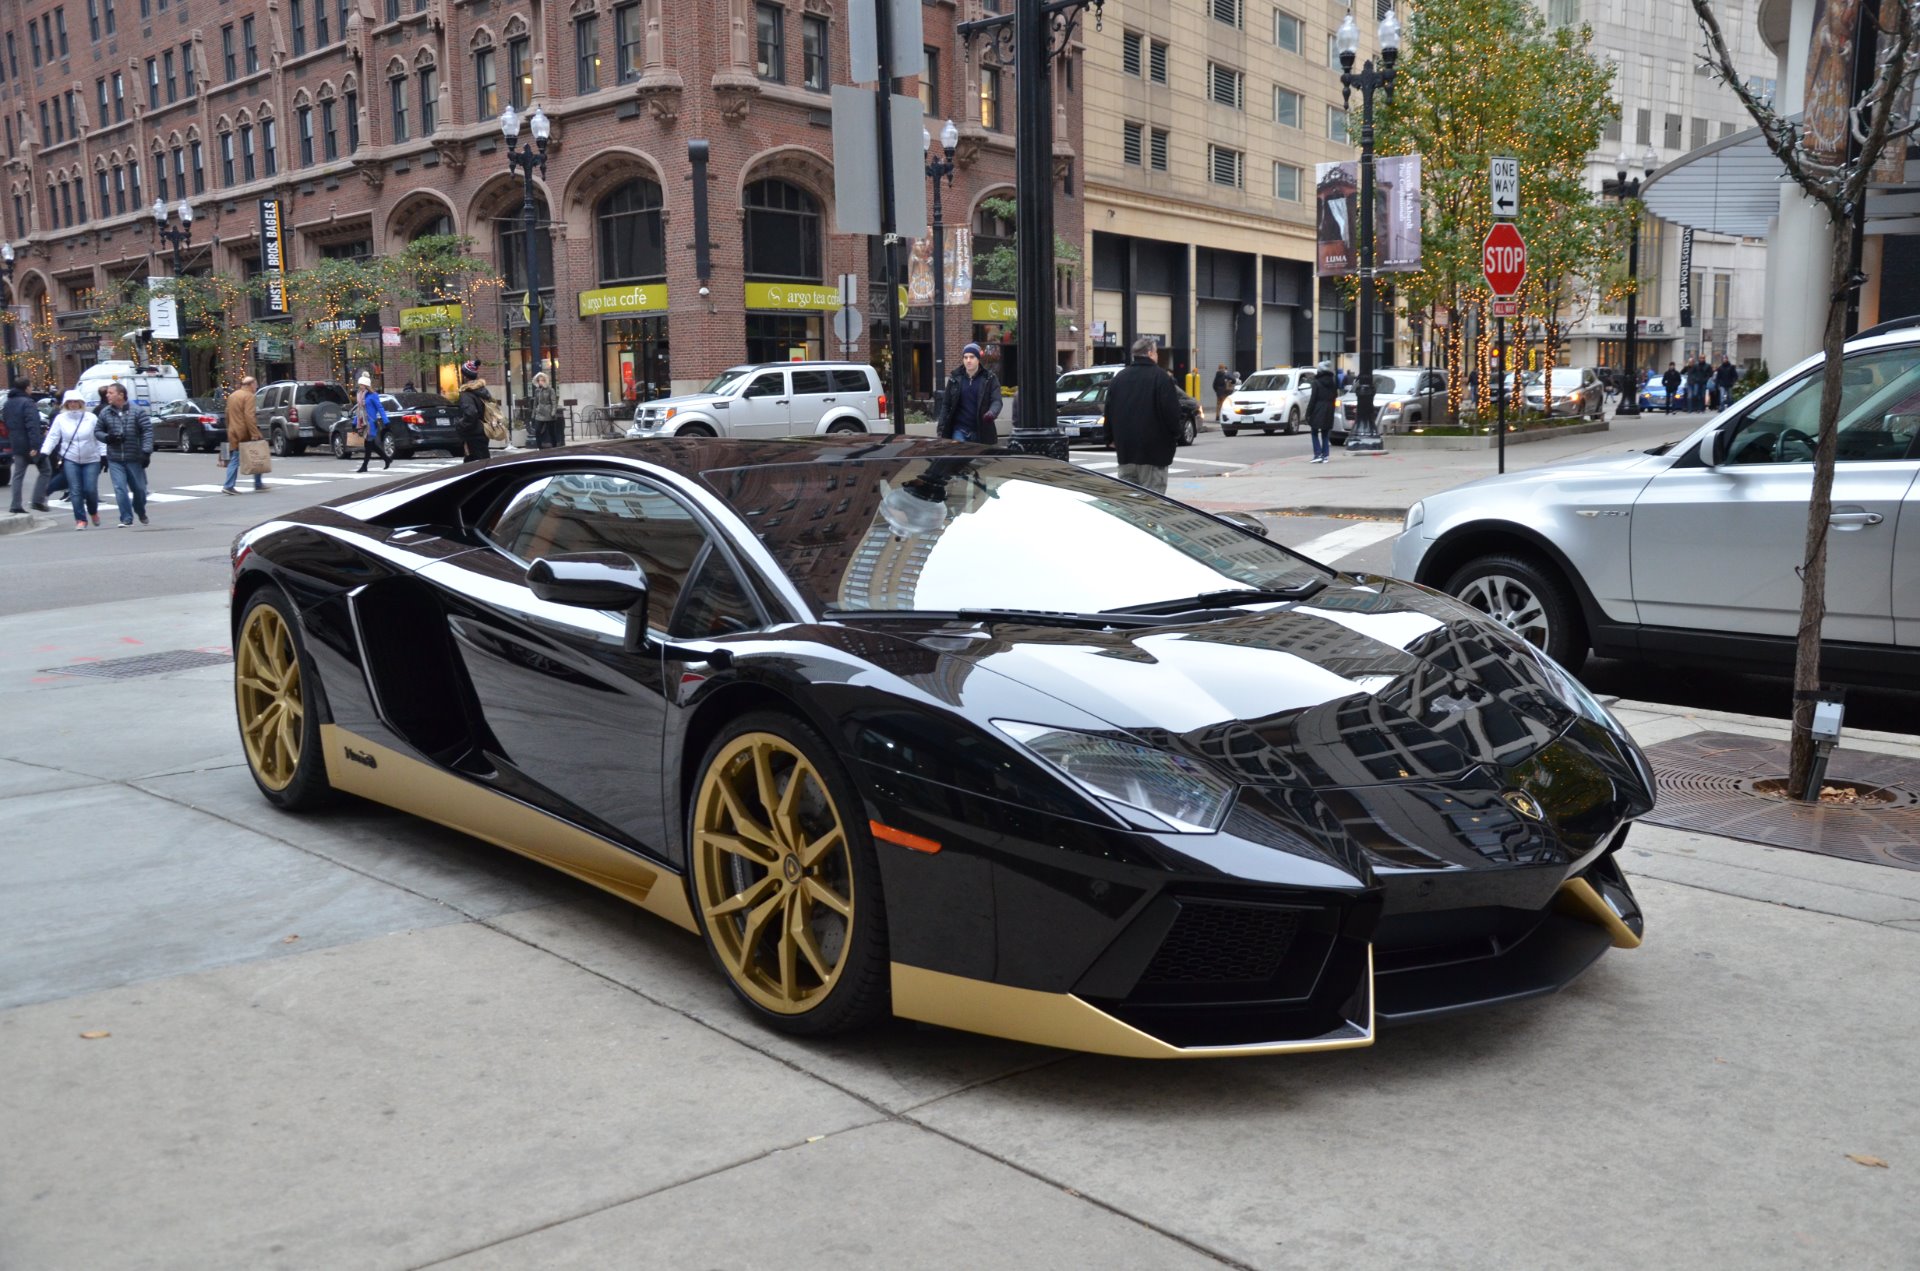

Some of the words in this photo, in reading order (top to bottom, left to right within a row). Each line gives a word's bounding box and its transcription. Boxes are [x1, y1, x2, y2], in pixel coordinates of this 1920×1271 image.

[1494, 162, 1515, 176] ONE
[1494, 180, 1516, 192] WAY
[264, 202, 277, 238] BAGELS
[267, 240, 280, 265] BROS.
[1486, 246, 1523, 273] STOP
[1681, 228, 1691, 284] NORDSTROM
[269, 268, 282, 310] EINSTIN
[587, 297, 602, 312] argo
[603, 295, 617, 307] tea
[620, 287, 647, 306] café
[787, 292, 810, 307] argo
[813, 291, 826, 304] tea
[1680, 287, 1690, 310] rack
[1495, 304, 1504, 313] ALL
[1505, 304, 1515, 313] WAY
